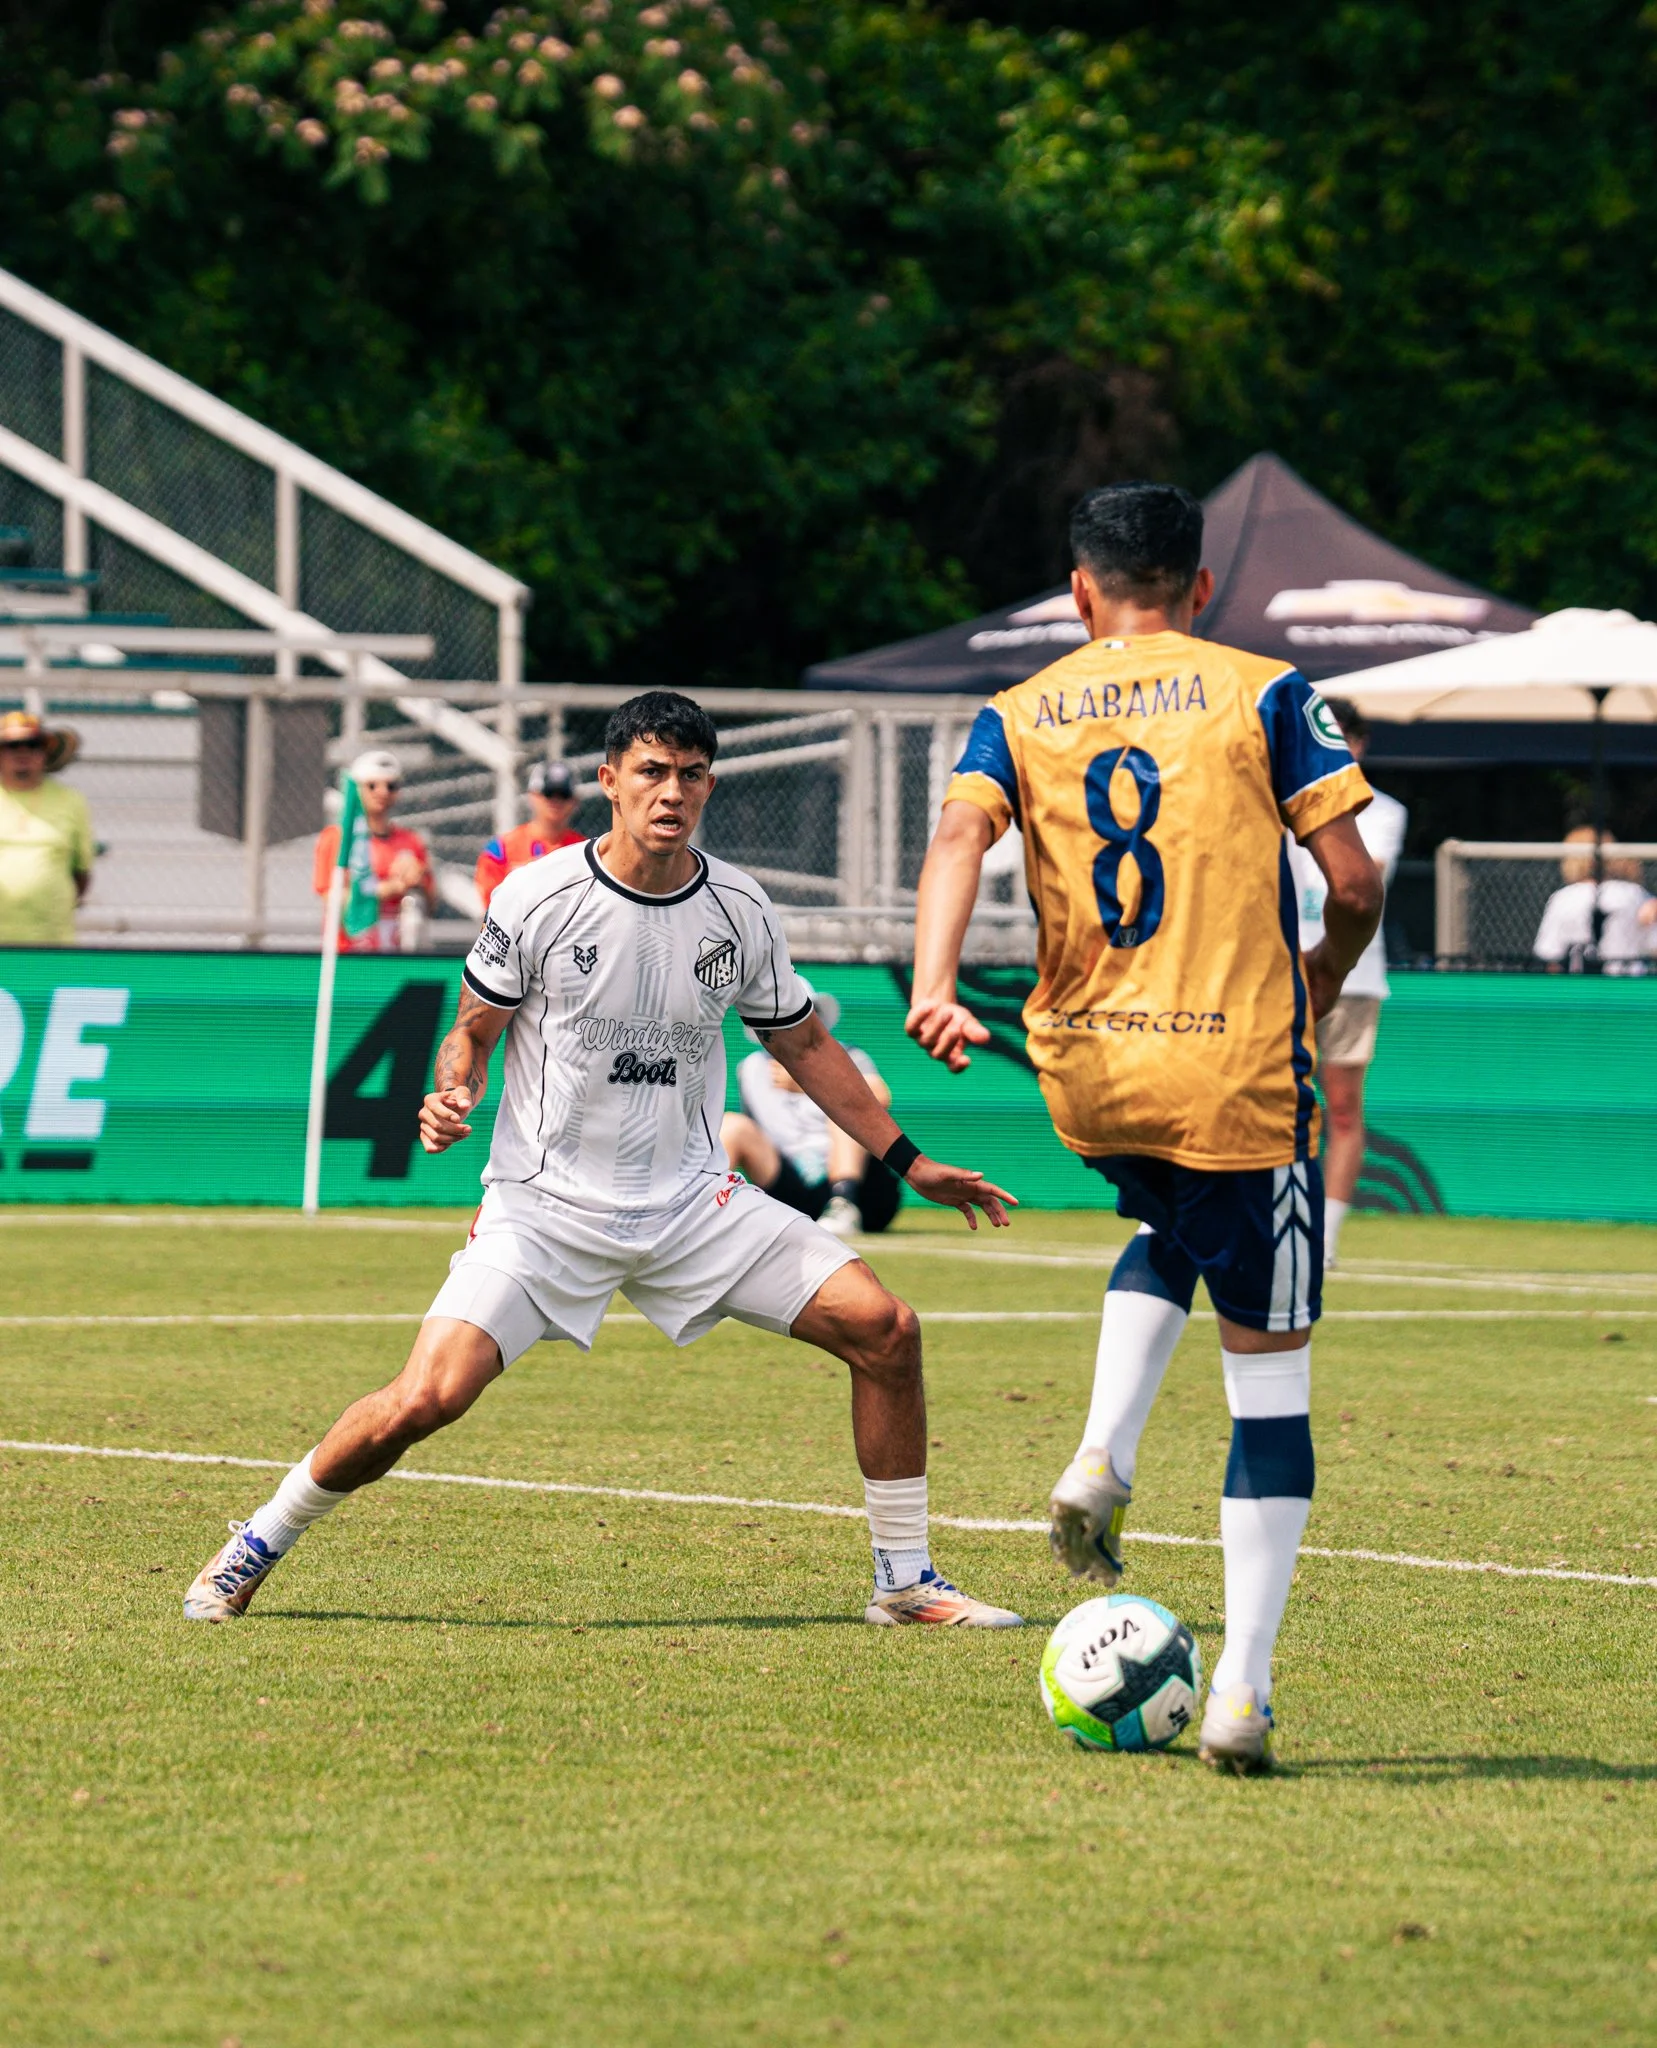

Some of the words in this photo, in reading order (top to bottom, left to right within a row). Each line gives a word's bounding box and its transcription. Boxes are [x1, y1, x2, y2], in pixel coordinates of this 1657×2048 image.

[1034, 673, 1207, 730] ALABAMA
[1083, 745, 1166, 949] 8
[322, 979, 447, 1179] 4
[607, 1051, 677, 1087] Boots
